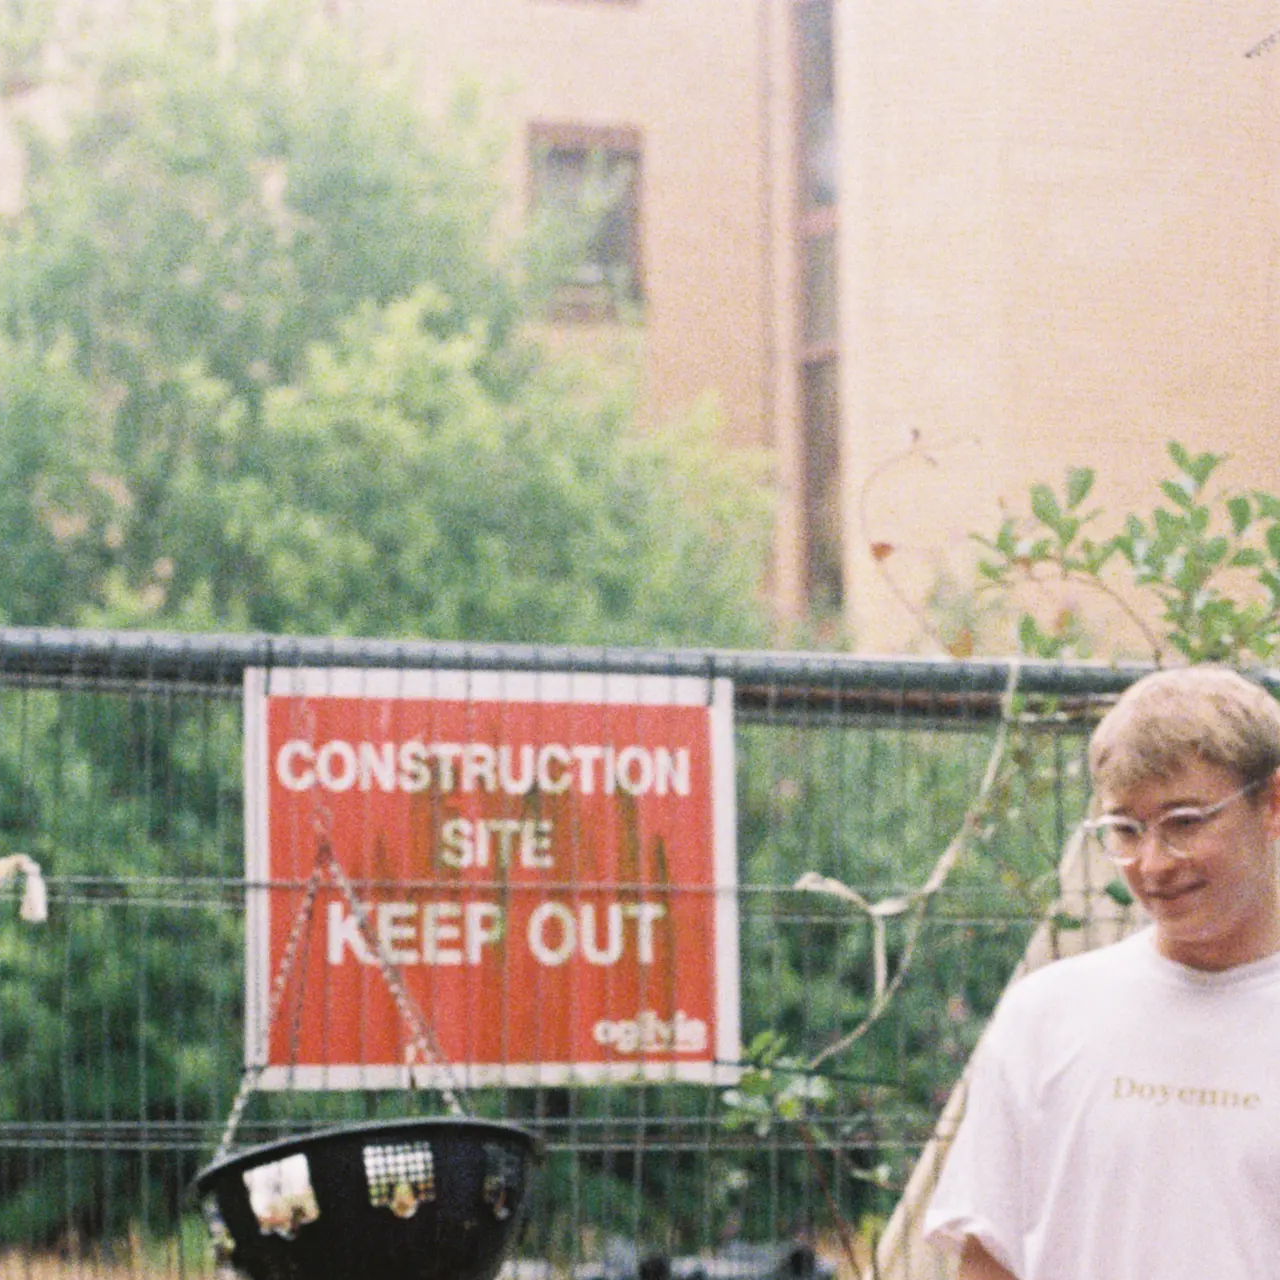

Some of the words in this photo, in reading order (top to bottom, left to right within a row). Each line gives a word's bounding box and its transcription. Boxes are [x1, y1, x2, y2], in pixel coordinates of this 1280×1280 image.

[276, 740, 691, 796] CONSTRUCTION
[439, 818, 554, 869] SITE
[326, 901, 505, 966] KEEP
[527, 902, 667, 967] OUT
